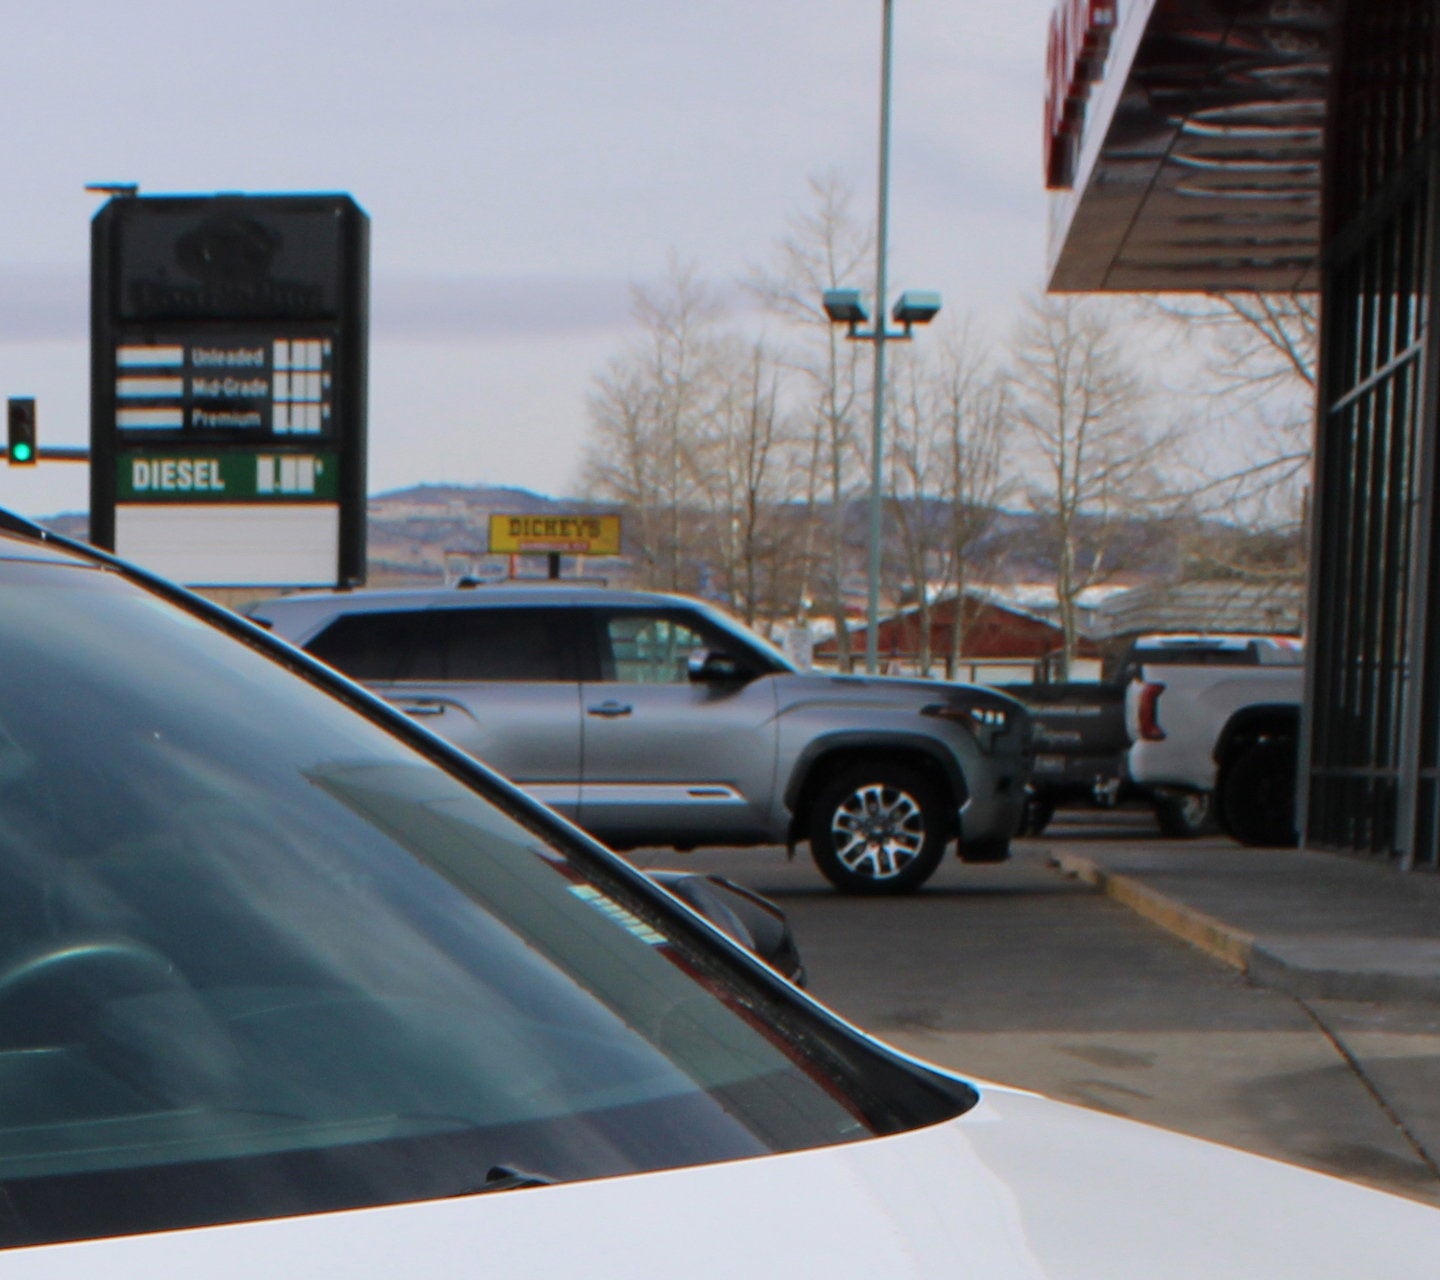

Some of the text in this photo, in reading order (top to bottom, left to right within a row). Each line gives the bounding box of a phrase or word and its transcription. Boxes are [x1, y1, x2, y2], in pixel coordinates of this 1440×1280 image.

[192, 348, 264, 367] Unleaded
[192, 408, 261, 427] Premium
[132, 459, 225, 491] DIESEL
